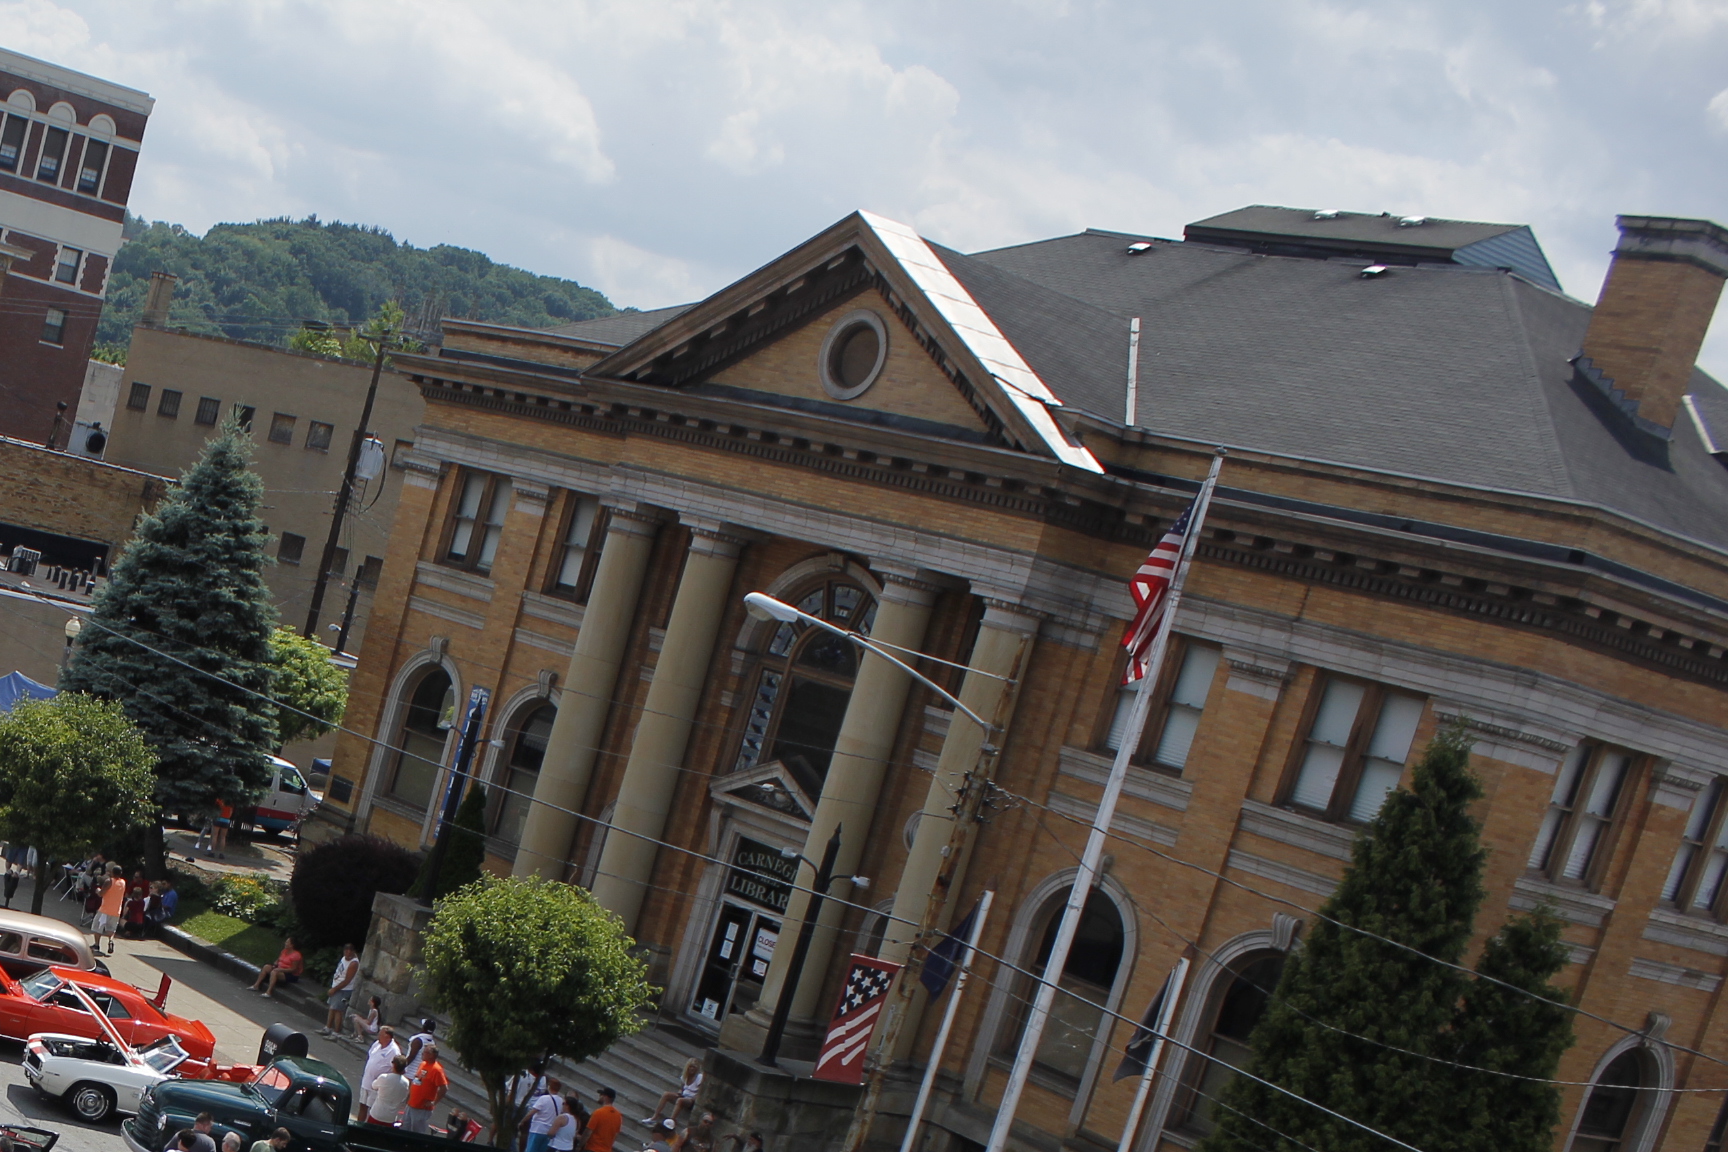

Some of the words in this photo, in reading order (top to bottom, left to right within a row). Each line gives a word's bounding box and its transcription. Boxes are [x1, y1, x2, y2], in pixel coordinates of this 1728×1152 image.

[737, 851, 798, 881] CARNEGI
[730, 874, 789, 909] LIBRAR
[758, 935, 776, 948] CLOSE
